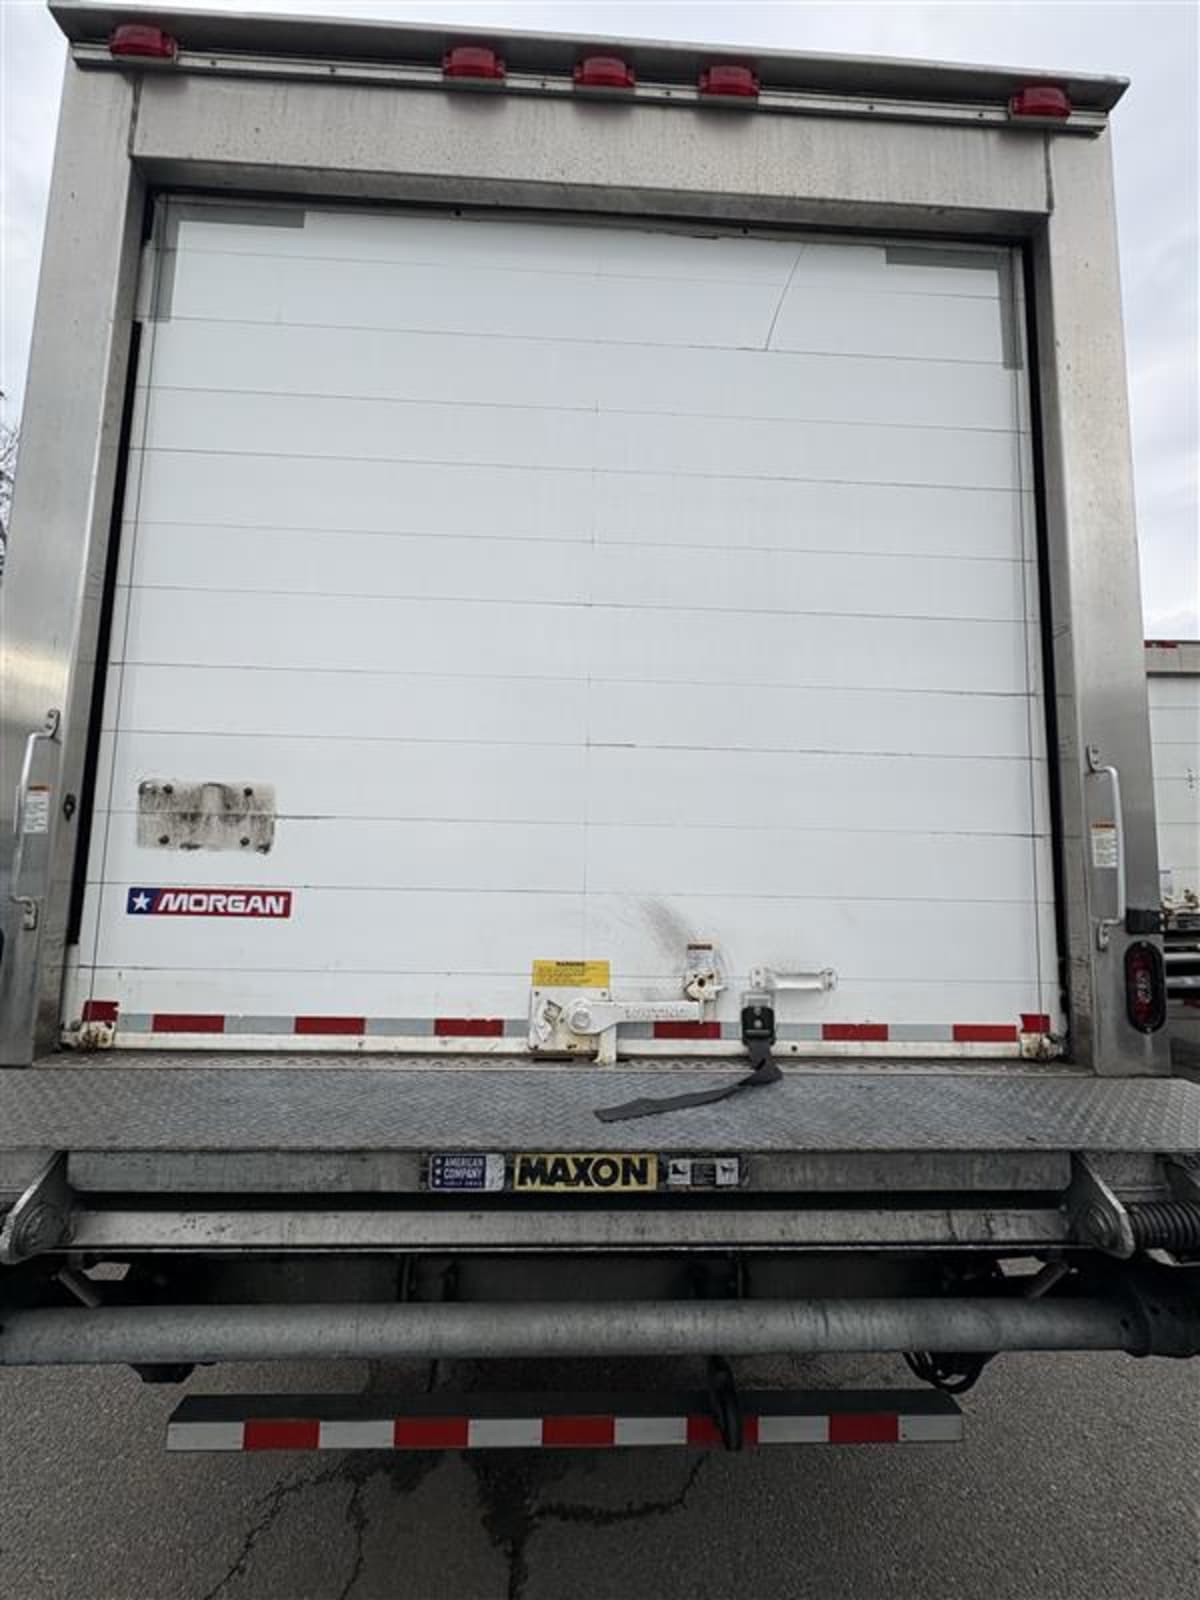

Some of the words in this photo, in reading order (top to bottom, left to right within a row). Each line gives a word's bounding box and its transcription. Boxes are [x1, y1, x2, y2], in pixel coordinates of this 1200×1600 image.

[158, 893, 287, 914] MORGAN
[444, 1157, 484, 1168] AMERICAN
[444, 1167, 483, 1180] COMPANY
[517, 1157, 648, 1187] MAXON
